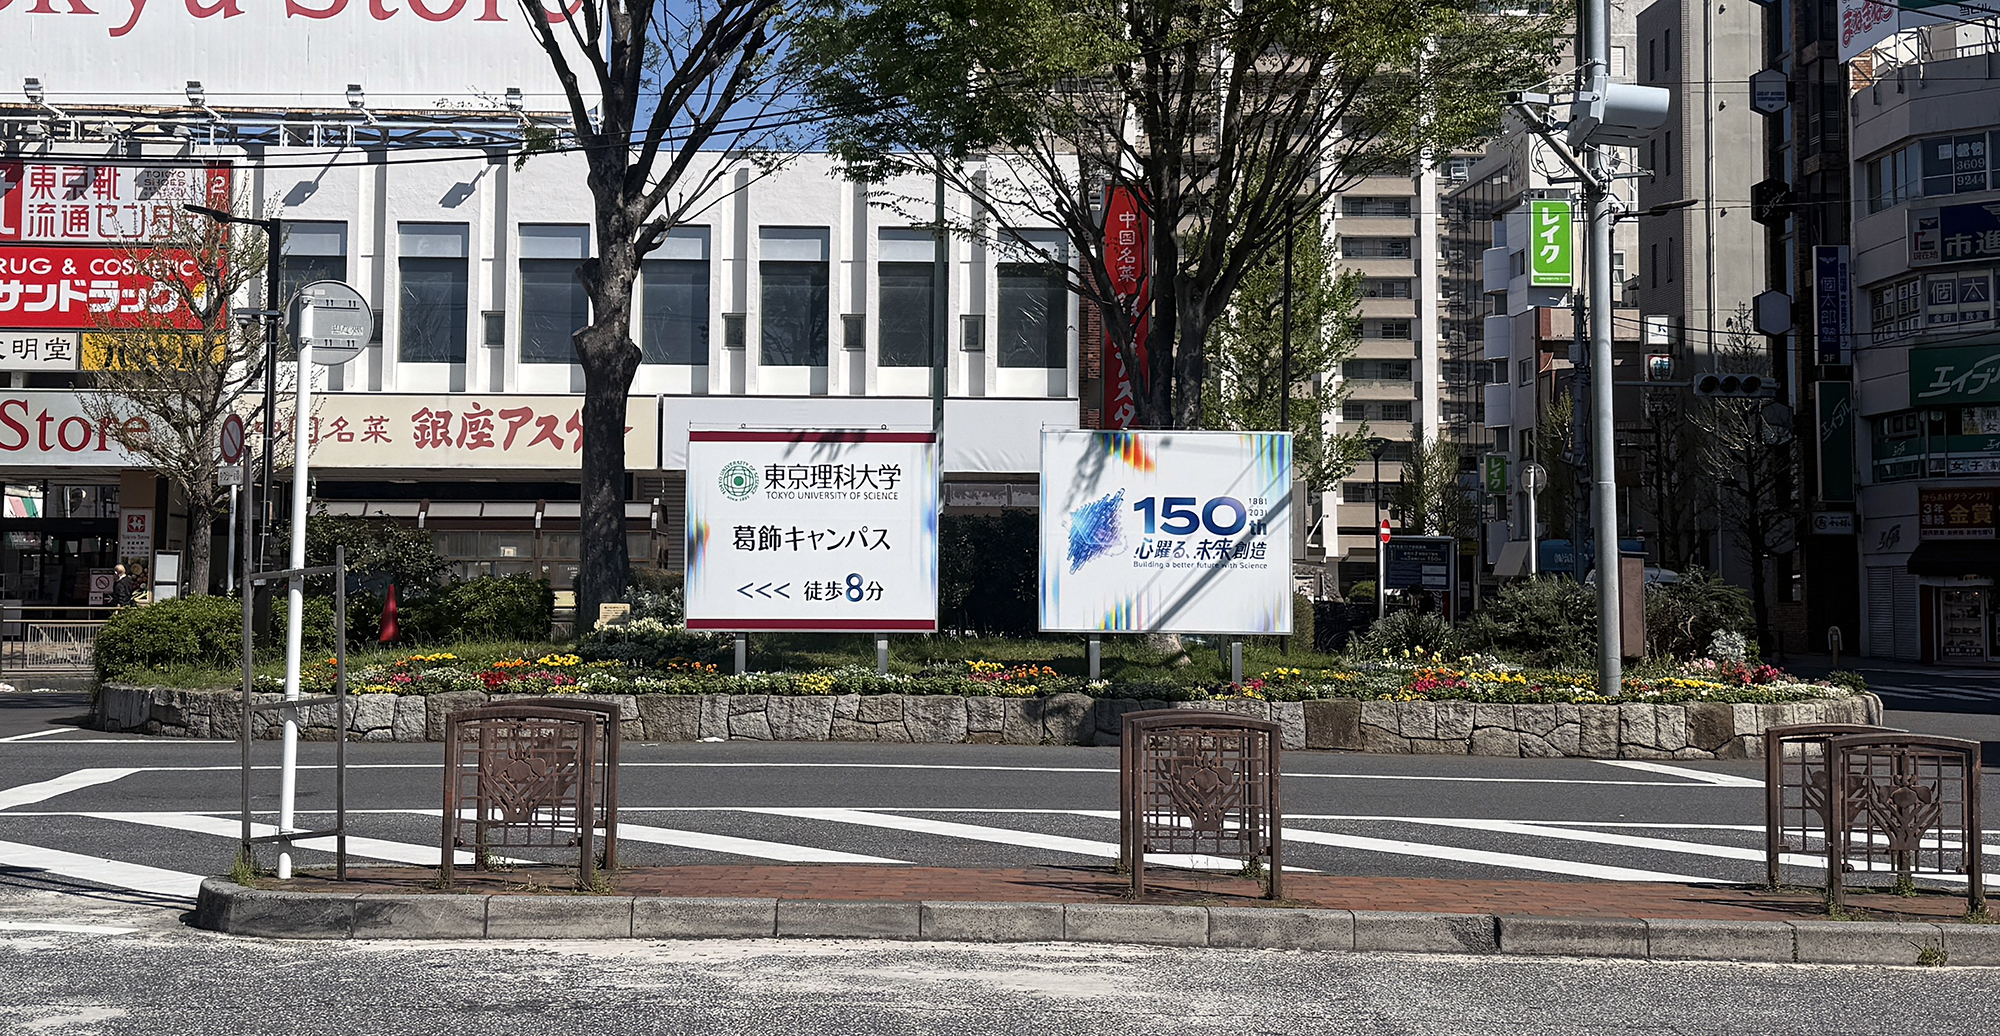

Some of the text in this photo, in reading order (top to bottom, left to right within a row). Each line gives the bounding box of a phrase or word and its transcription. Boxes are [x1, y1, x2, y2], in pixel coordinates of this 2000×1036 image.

[1957, 158, 1985, 170] 3609
[30, 165, 121, 200] 東京靴
[1957, 174, 1985, 186] 9244
[1117, 210, 1136, 282] 中国名菜
[1540, 207, 1560, 264] レイク
[1944, 230, 2000, 257] 市進
[61, 258, 77, 275] &
[1823, 354, 1836, 363] 3F
[410, 402, 634, 451] 銀座アス
[764, 463, 901, 490] 東京理科大学
[1490, 458, 1501, 489] レイク
[766, 491, 899, 500] TOKYO UNIVERSITY OF SCIENCE
[1248, 497, 1267, 505] 1881
[1133, 496, 1247, 536] 150
[1248, 508, 1267, 517] 2031
[1923, 503, 1945, 514] 3年
[1948, 503, 1993, 525] 金賞
[732, 525, 891, 552] 葛飾キャンパス
[1248, 519, 1268, 536] th
[1133, 537, 1268, 561] 心躍る、未来創造
[1133, 561, 1164, 569] Building
[1196, 561, 1219, 569] future
[1221, 561, 1238, 569] with
[1239, 561, 1268, 569] Science
[803, 573, 885, 603] 徒歩8分
